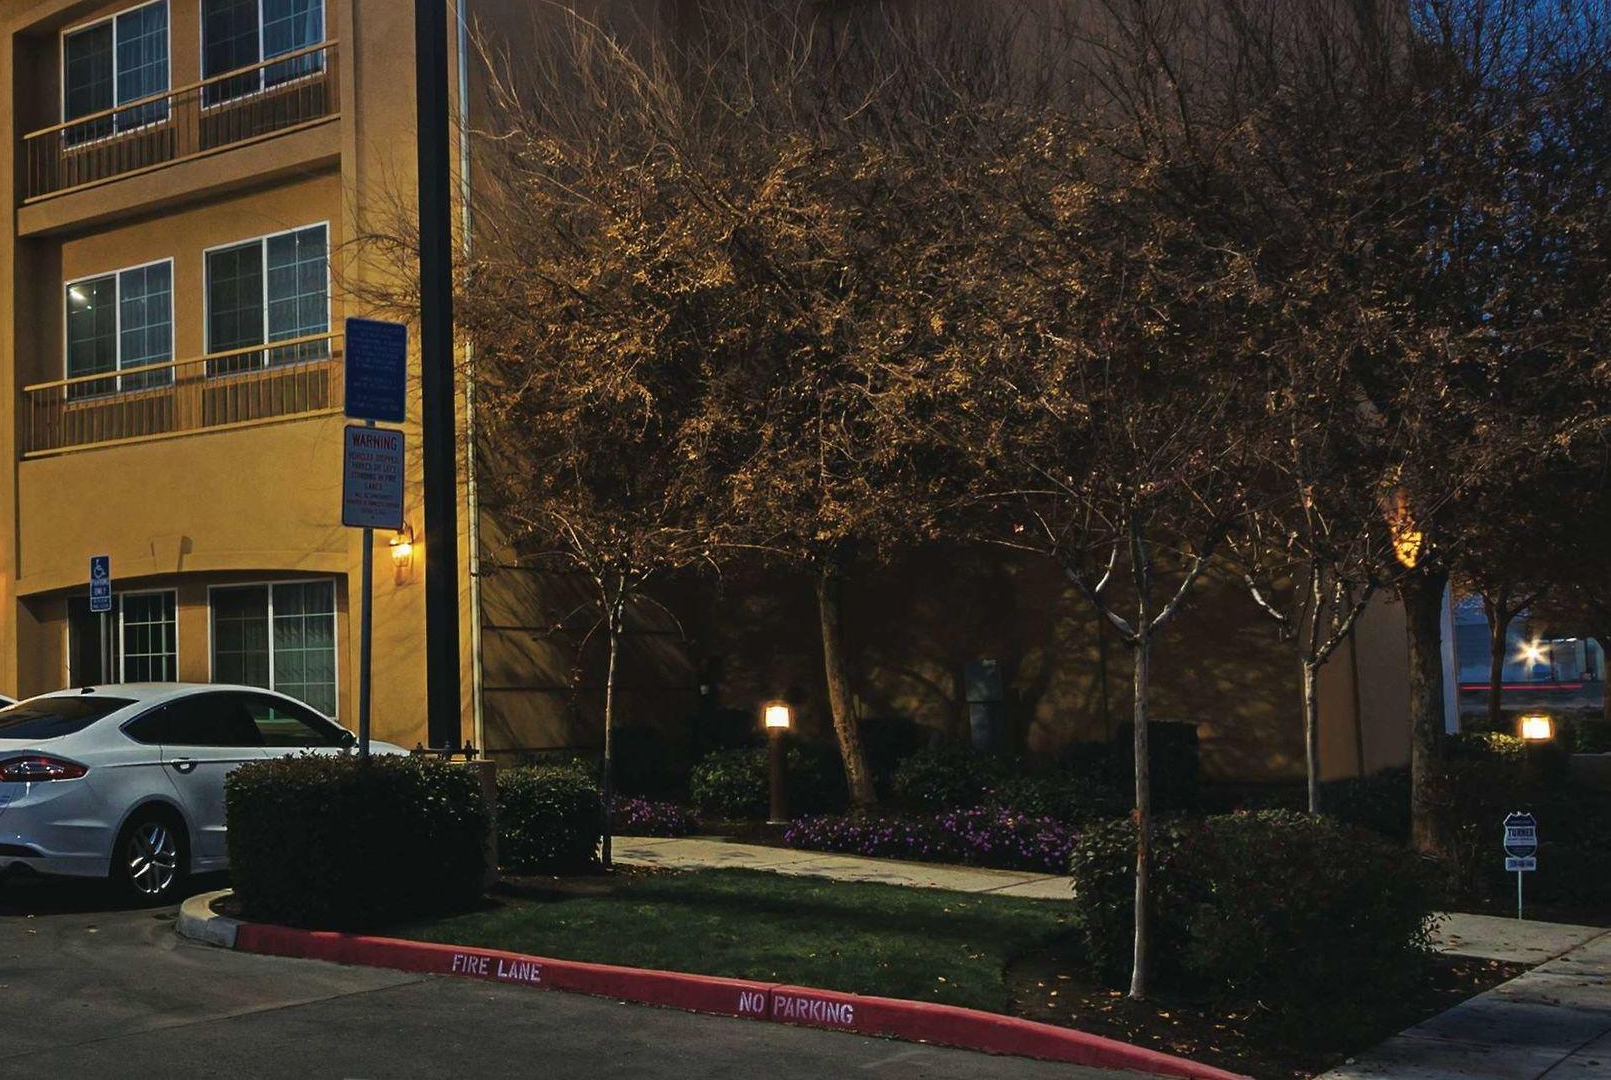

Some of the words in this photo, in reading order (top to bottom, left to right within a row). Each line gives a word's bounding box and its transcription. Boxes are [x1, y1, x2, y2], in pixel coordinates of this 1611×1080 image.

[352, 433, 398, 451] WARNING
[452, 954, 490, 976] FIRE
[497, 958, 542, 983] LANE
[739, 991, 765, 1015] NO
[773, 995, 854, 1025] PARKING
